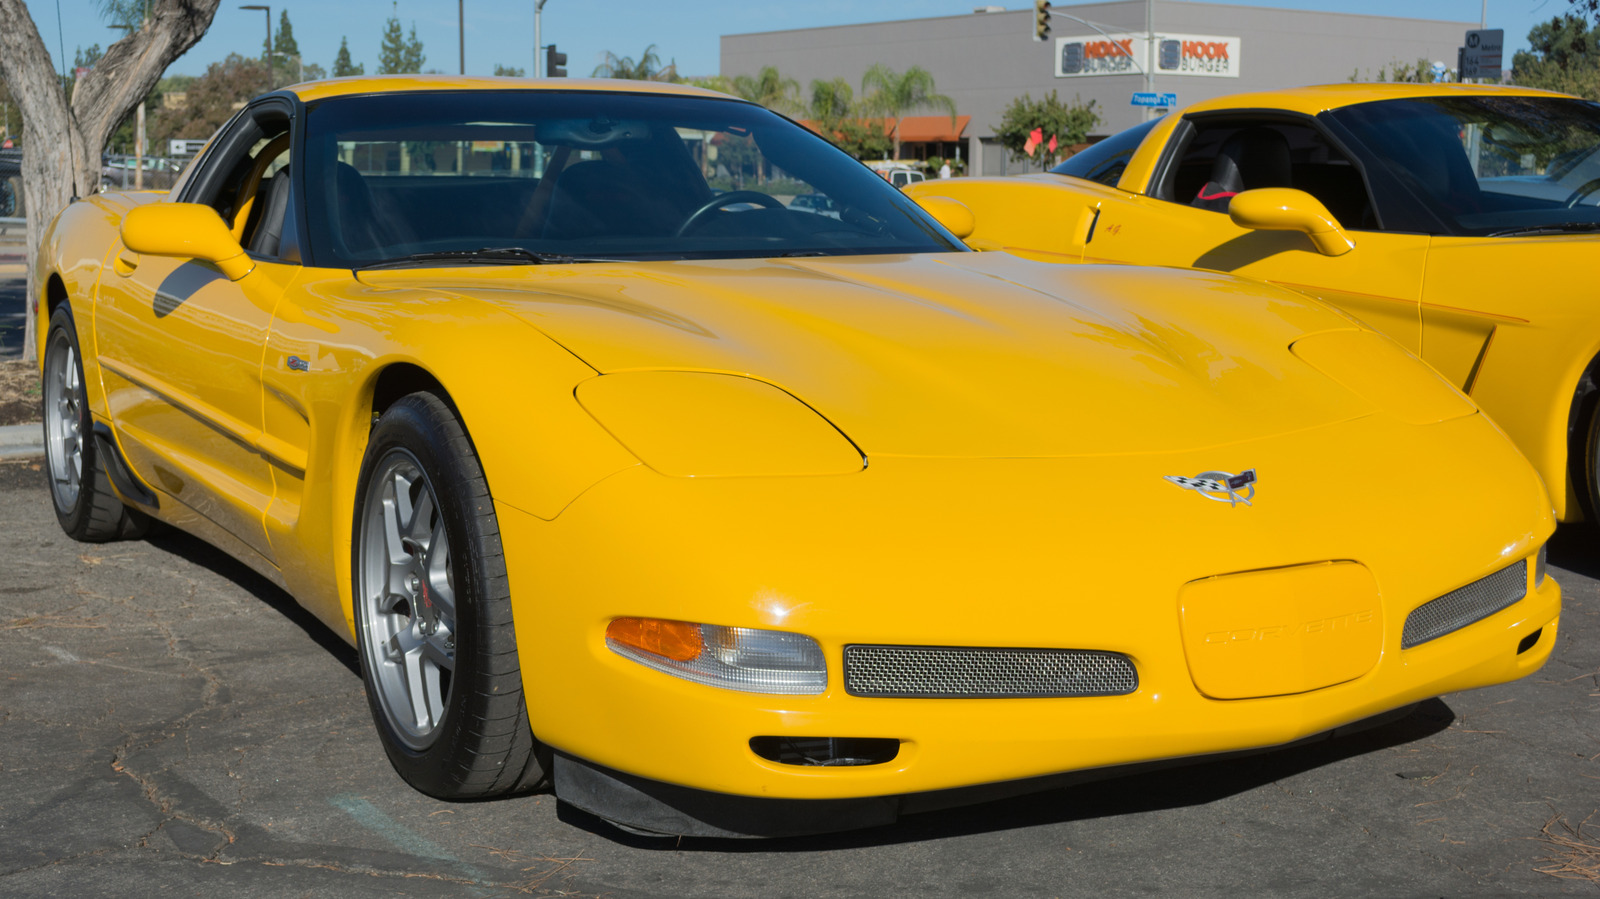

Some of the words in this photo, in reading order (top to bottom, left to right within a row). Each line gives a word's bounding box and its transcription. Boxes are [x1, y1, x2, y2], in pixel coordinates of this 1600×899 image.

[1085, 38, 1133, 58] HOOK
[1182, 40, 1229, 60] HOOK
[1182, 58, 1229, 73] BURGER
[1203, 609, 1373, 646] CORVETTE
